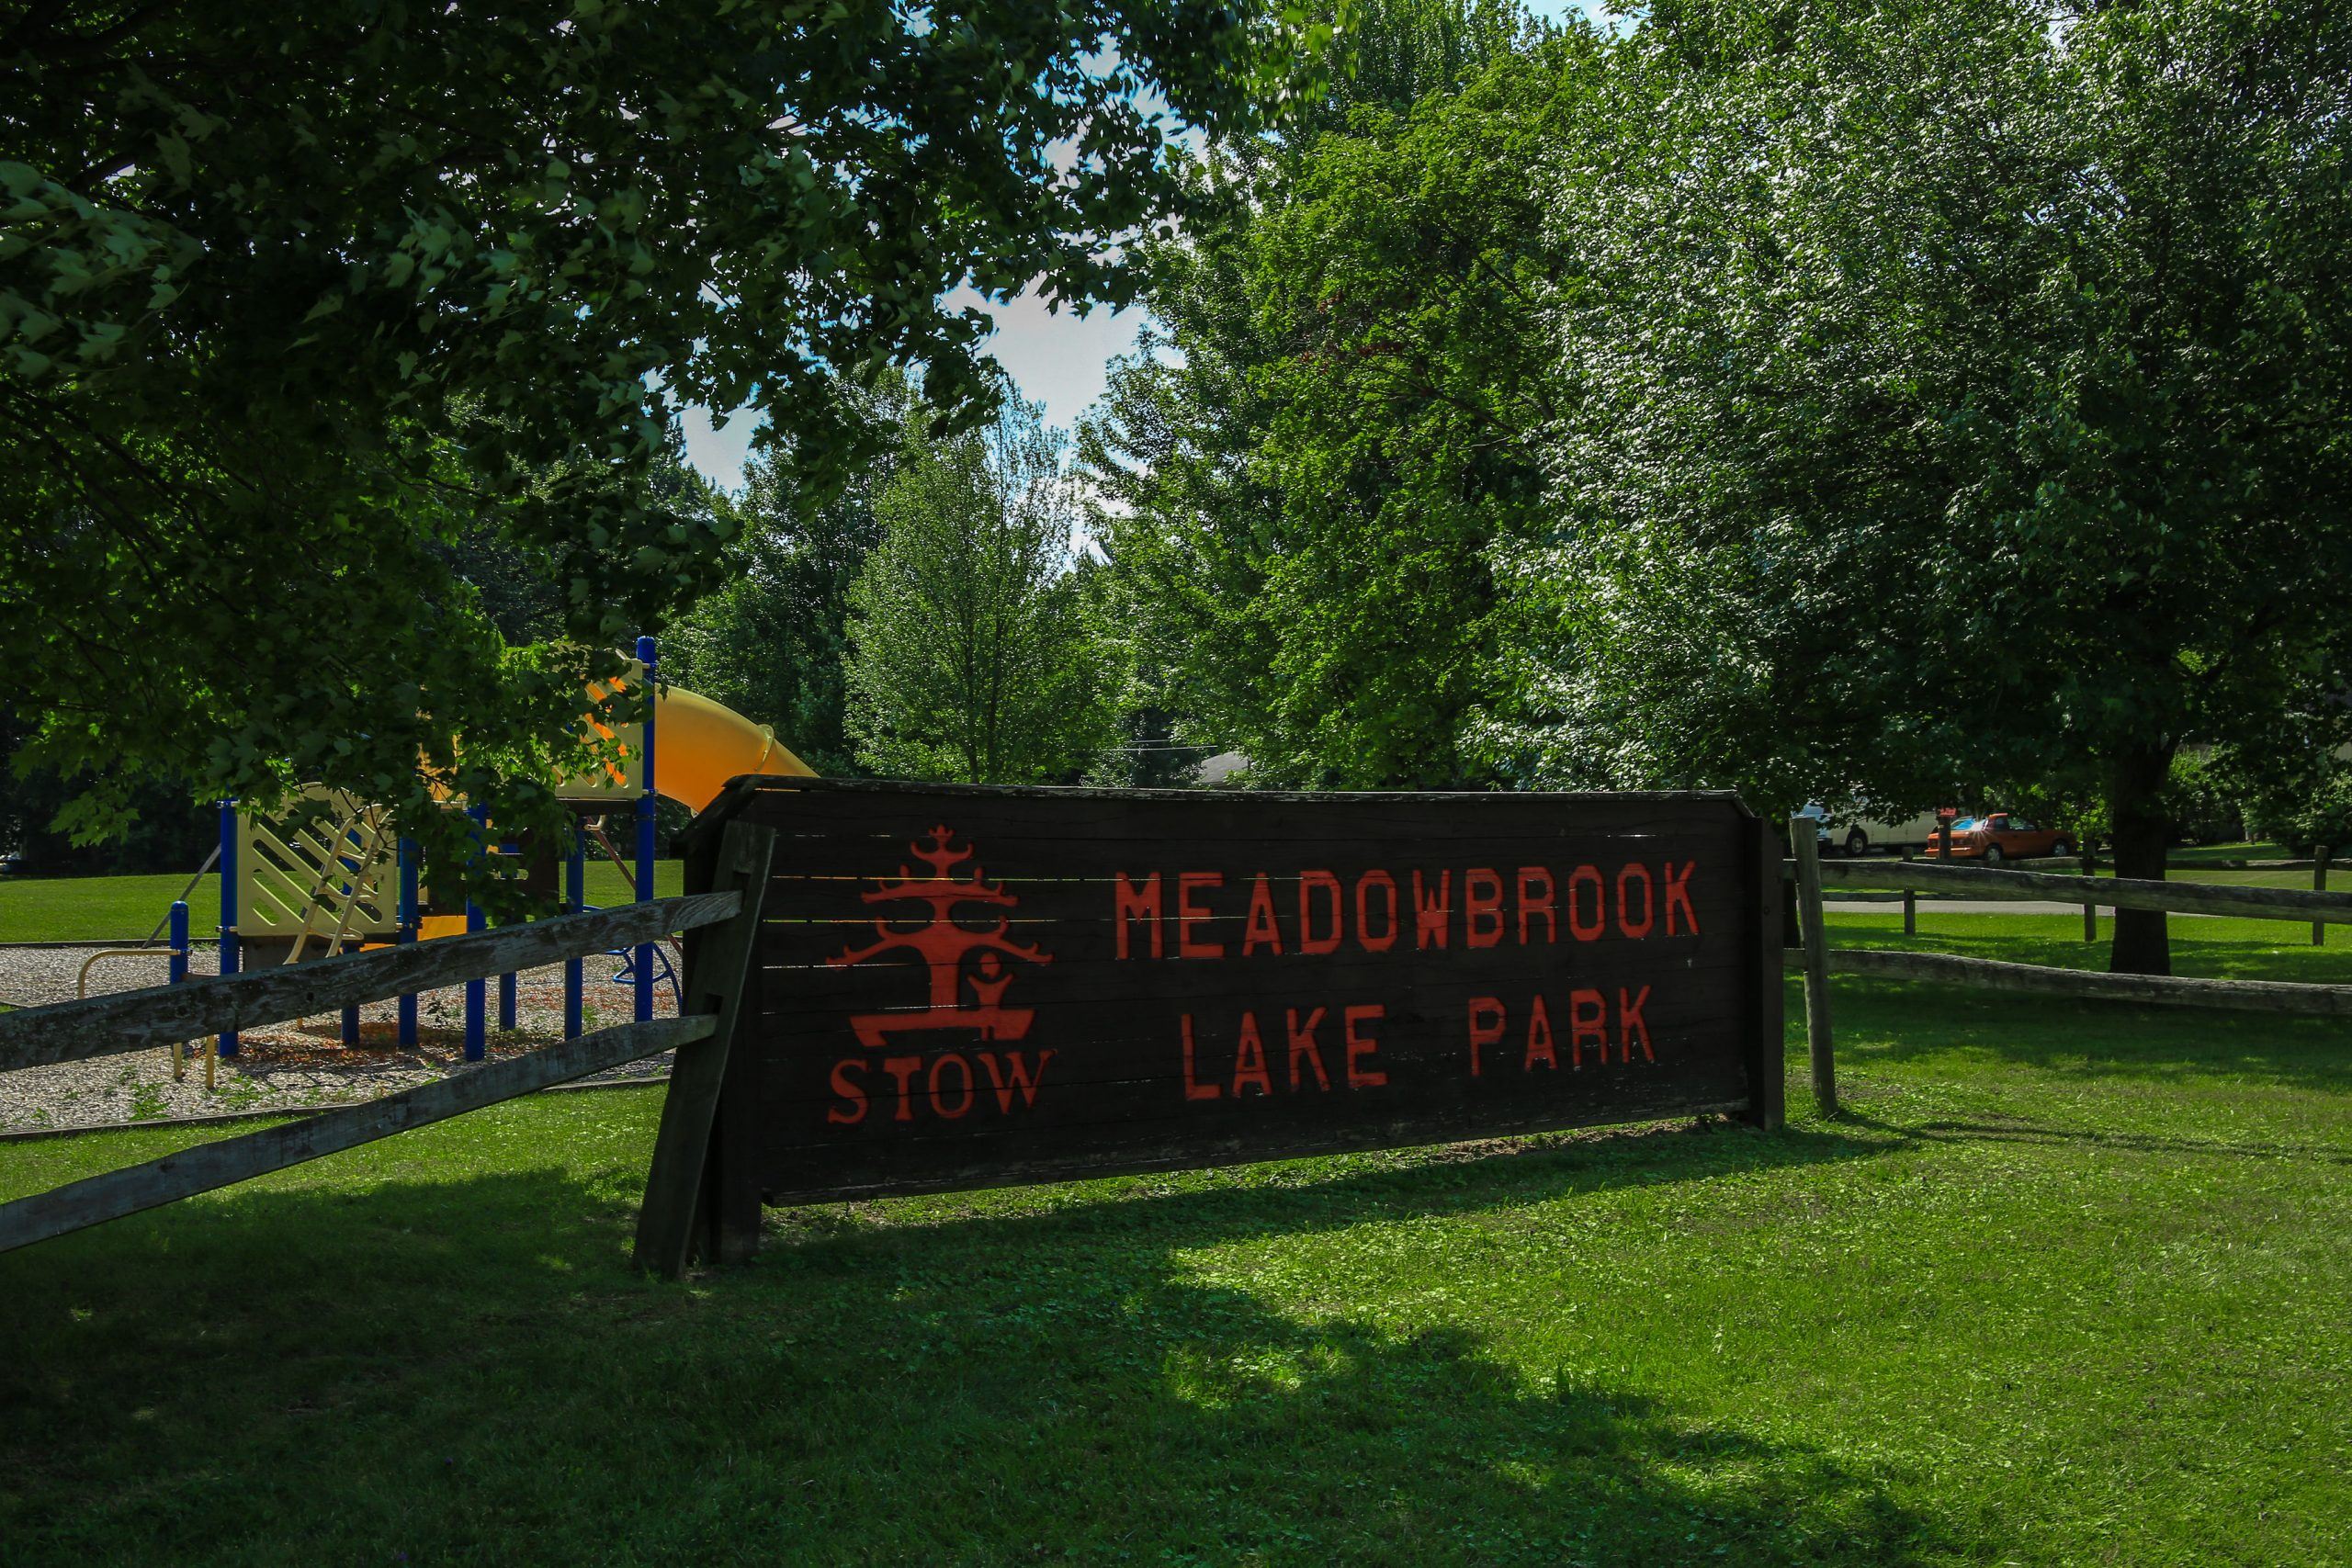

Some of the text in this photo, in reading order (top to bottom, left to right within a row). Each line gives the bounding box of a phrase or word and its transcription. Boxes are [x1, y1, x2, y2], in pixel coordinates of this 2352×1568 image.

[1114, 861, 1700, 960] MEADOWBROOK
[827, 1049, 1057, 1124] STOW
[1181, 985, 1655, 1101] LAKE PARK
